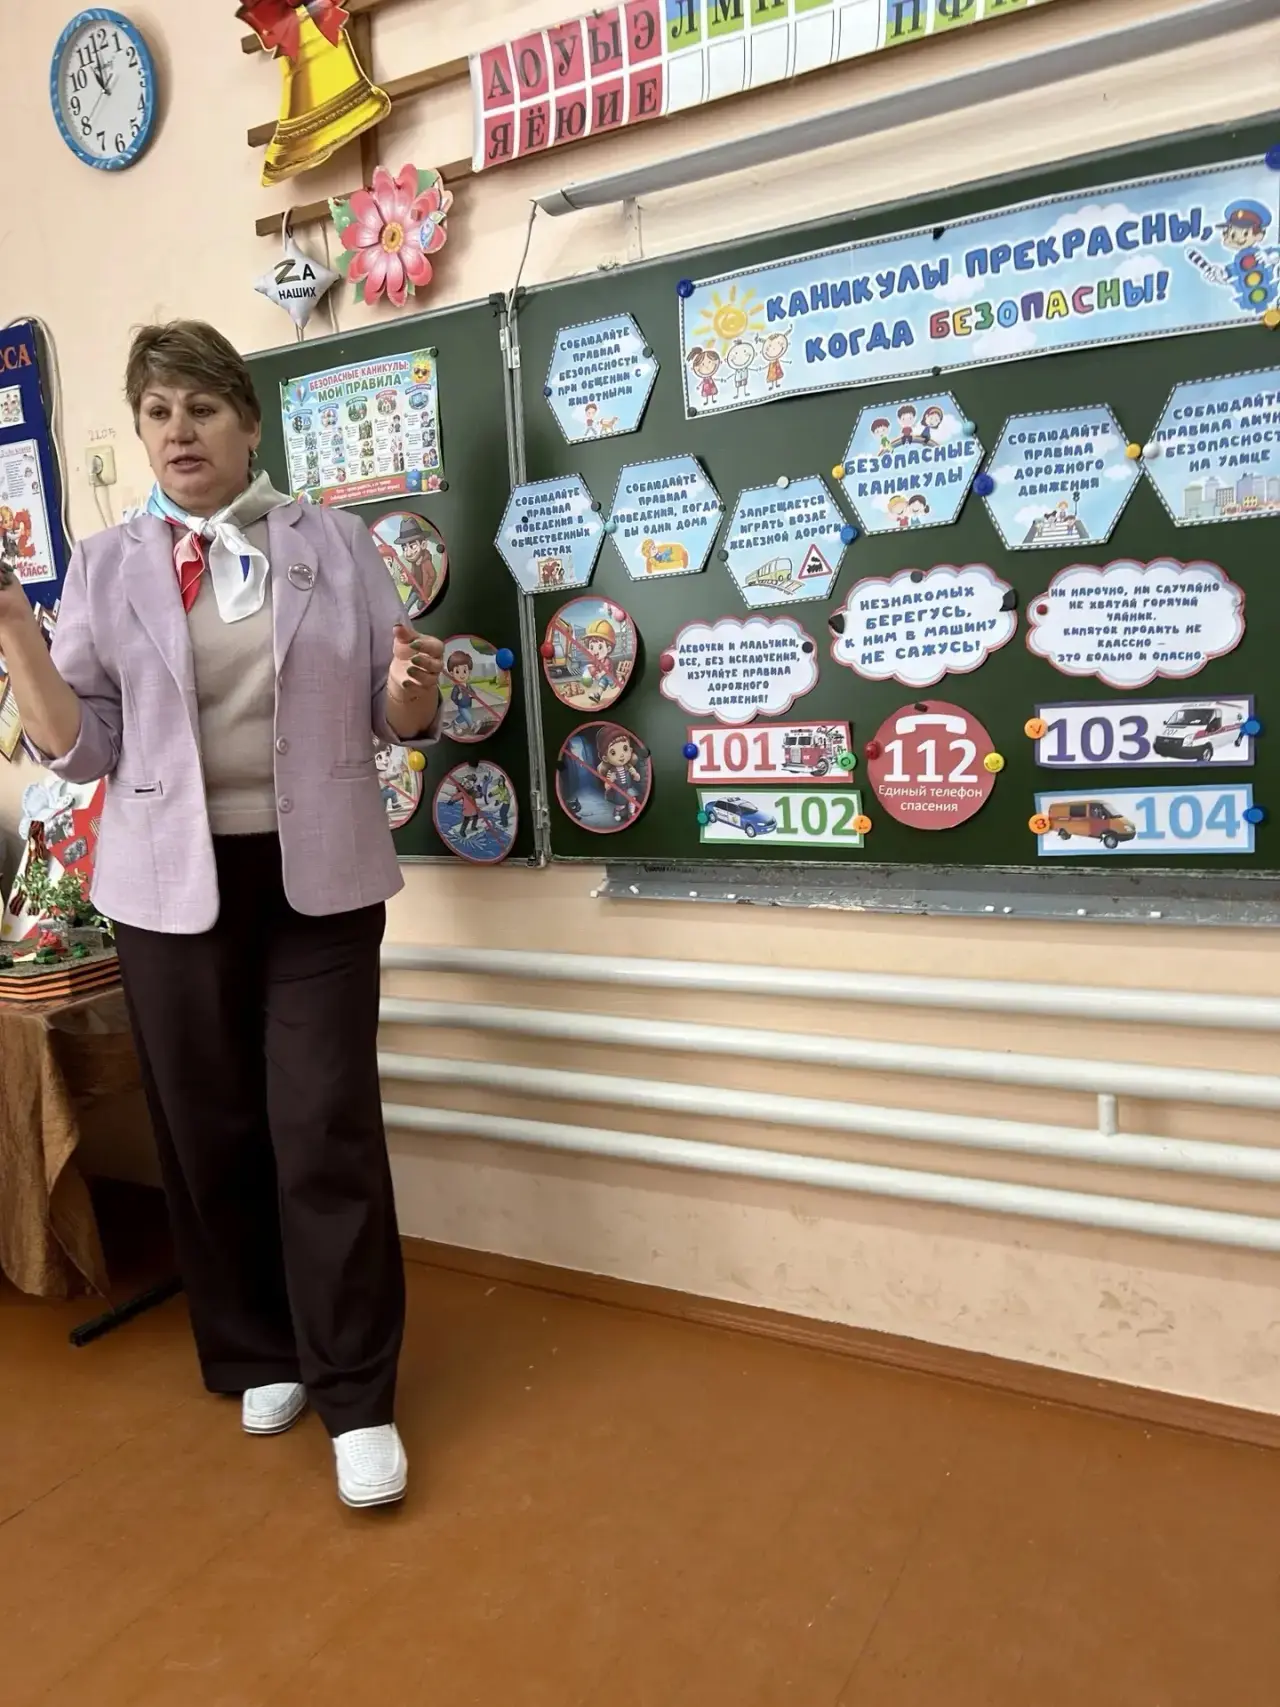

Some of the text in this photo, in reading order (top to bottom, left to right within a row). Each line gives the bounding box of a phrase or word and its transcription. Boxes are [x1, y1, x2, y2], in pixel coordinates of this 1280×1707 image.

[112, 32, 122, 52] 1
[76, 45, 94, 68] 11
[126, 47, 138, 68] 2
[70, 69, 87, 92] 10
[70, 96, 81, 115] 9
[81, 116, 92, 135] 8
[96, 131, 105, 151] 7
[115, 133, 125, 153] 6
[766, 207, 1213, 322] КАНИКУЛЫ ПРЕКРАСНЫ,
[278, 287, 316, 300] НАШИХ
[805, 271, 1169, 363] КОГДА БЕЗОПАСНЫ!
[560, 327, 630, 351] СОБЛЮДАЙТЕ
[573, 344, 620, 362] ПРАВИЛА
[310, 361, 408, 390] БЕЗОПАСНЫЕ КАНИКУЛЫ:
[559, 356, 638, 381] БЕЗОПАСНОСТИ
[319, 388, 342, 402] МОИ
[346, 374, 401, 395] ПРАВИЛА
[558, 369, 641, 396] ПРИ ОБЩЕНИИ С
[569, 386, 632, 406] ЖИВОТНЫМИ
[1008, 423, 1110, 445] СОБЛЮДАЙТЕ
[1157, 418, 1231, 441] ПРАВИЛА
[845, 440, 975, 475] БЕЗОПАСНЫЕ
[1024, 443, 1093, 460] ПРАВИЛА
[1189, 449, 1271, 472] НА УЛИЦЕ
[1014, 460, 1104, 480] ДОРОЖНОГО
[626, 474, 696, 494] СОБЛЮДАЙТЕ
[858, 467, 963, 497] КАНИКУЛЫ
[1019, 477, 1099, 496] ДВИЖЕНИЯ
[516, 488, 580, 506] СОБЛЮДАЙТЕ
[638, 490, 687, 505] ПРАВИЛА
[740, 495, 825, 518] ЗАПРЕЩАЕТСЯ
[526, 502, 571, 518] ПРАВИЛА
[613, 500, 718, 524] ПОВЕДЕНИЯ, КОГДА
[516, 516, 573, 533] ПОВЕДЕНИЯ
[625, 517, 707, 537] ВЫ ОДНИ ДОМА
[740, 510, 826, 534] ИГРАТЬ ВОЗЛЕ
[511, 528, 590, 547] ОБЩЕСТВЕННЫХ
[730, 523, 841, 550] ЖЕЛЕЗНОЙ ДОРОГИ
[533, 545, 571, 557] МЕСТАХ
[20, 565, 48, 577] КЛАСС
[860, 586, 975, 611] НЕЗНАКОМЫХ
[1051, 583, 1219, 596] НИ НАРОЧНО, НИ СЛУЧАЙНО
[1069, 597, 1198, 609] НЕ ХВАТАЙ ГОРЯЧИЙ
[866, 606, 971, 630] БЕРЕГУСЬ,
[845, 619, 996, 648] К НИМ В МАШИНУ
[1064, 624, 1201, 636] КИПЯТОК ПРОЛИТЬ НЕ
[679, 638, 799, 653] ДЕВОЧКИ И МАЛЬЧИКИ,
[861, 640, 980, 665] НЕ САЖУСЬ!
[1098, 639, 1151, 648] КЛАССНО
[679, 652, 799, 667] ВСЕ, БЕЗ ИСКЛЮЧЕНИЯ,
[1058, 651, 1205, 662] ЭТО БОЛЬНО И ОПАСНО.
[688, 666, 791, 680] ИЗУЧАЙТЕ ПРАВИЛА
[708, 681, 769, 691] ДОРОЖНОГО
[709, 695, 768, 705] ДВИЖЕНИЯ!
[1047, 715, 1151, 762] 103
[699, 731, 776, 772] 101
[883, 739, 979, 783] 112
[878, 783, 983, 799] Единый телефон
[774, 796, 857, 836] 102
[900, 800, 959, 812] спасения
[1136, 794, 1241, 840] 104
